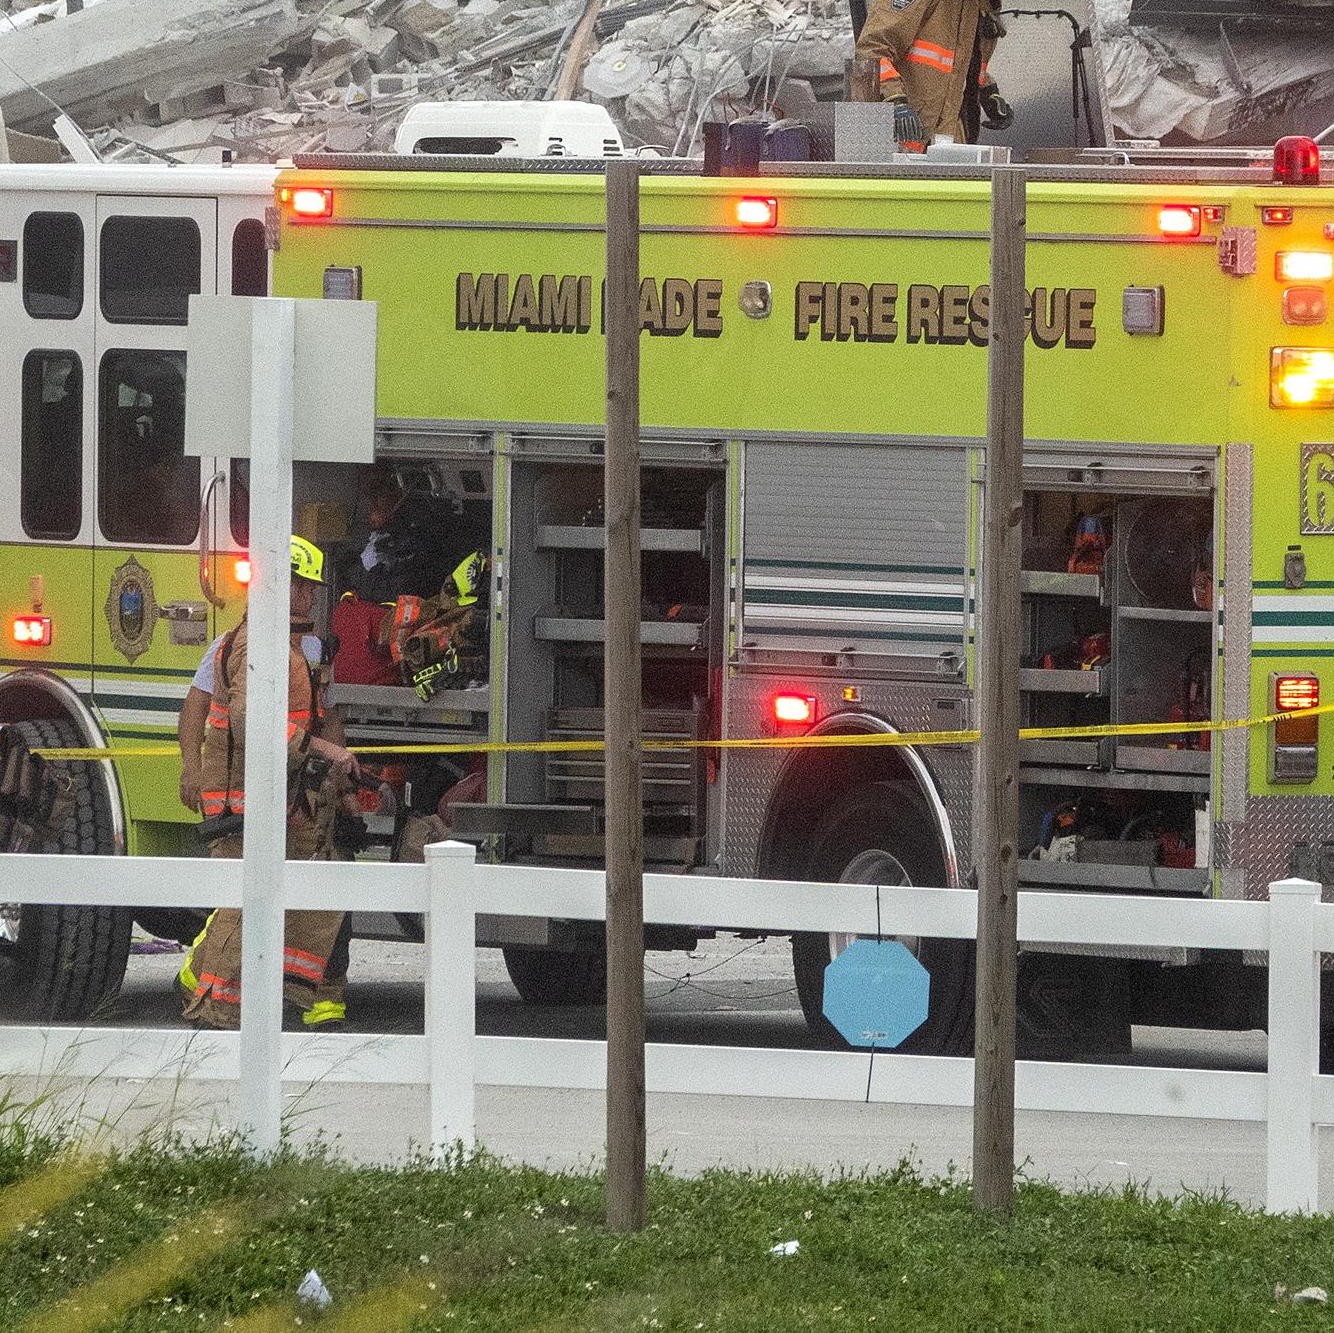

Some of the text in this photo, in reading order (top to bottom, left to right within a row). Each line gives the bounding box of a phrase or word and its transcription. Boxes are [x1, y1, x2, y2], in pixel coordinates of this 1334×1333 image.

[456, 272, 724, 339] MIAMI ADE
[794, 281, 899, 343] FIRE
